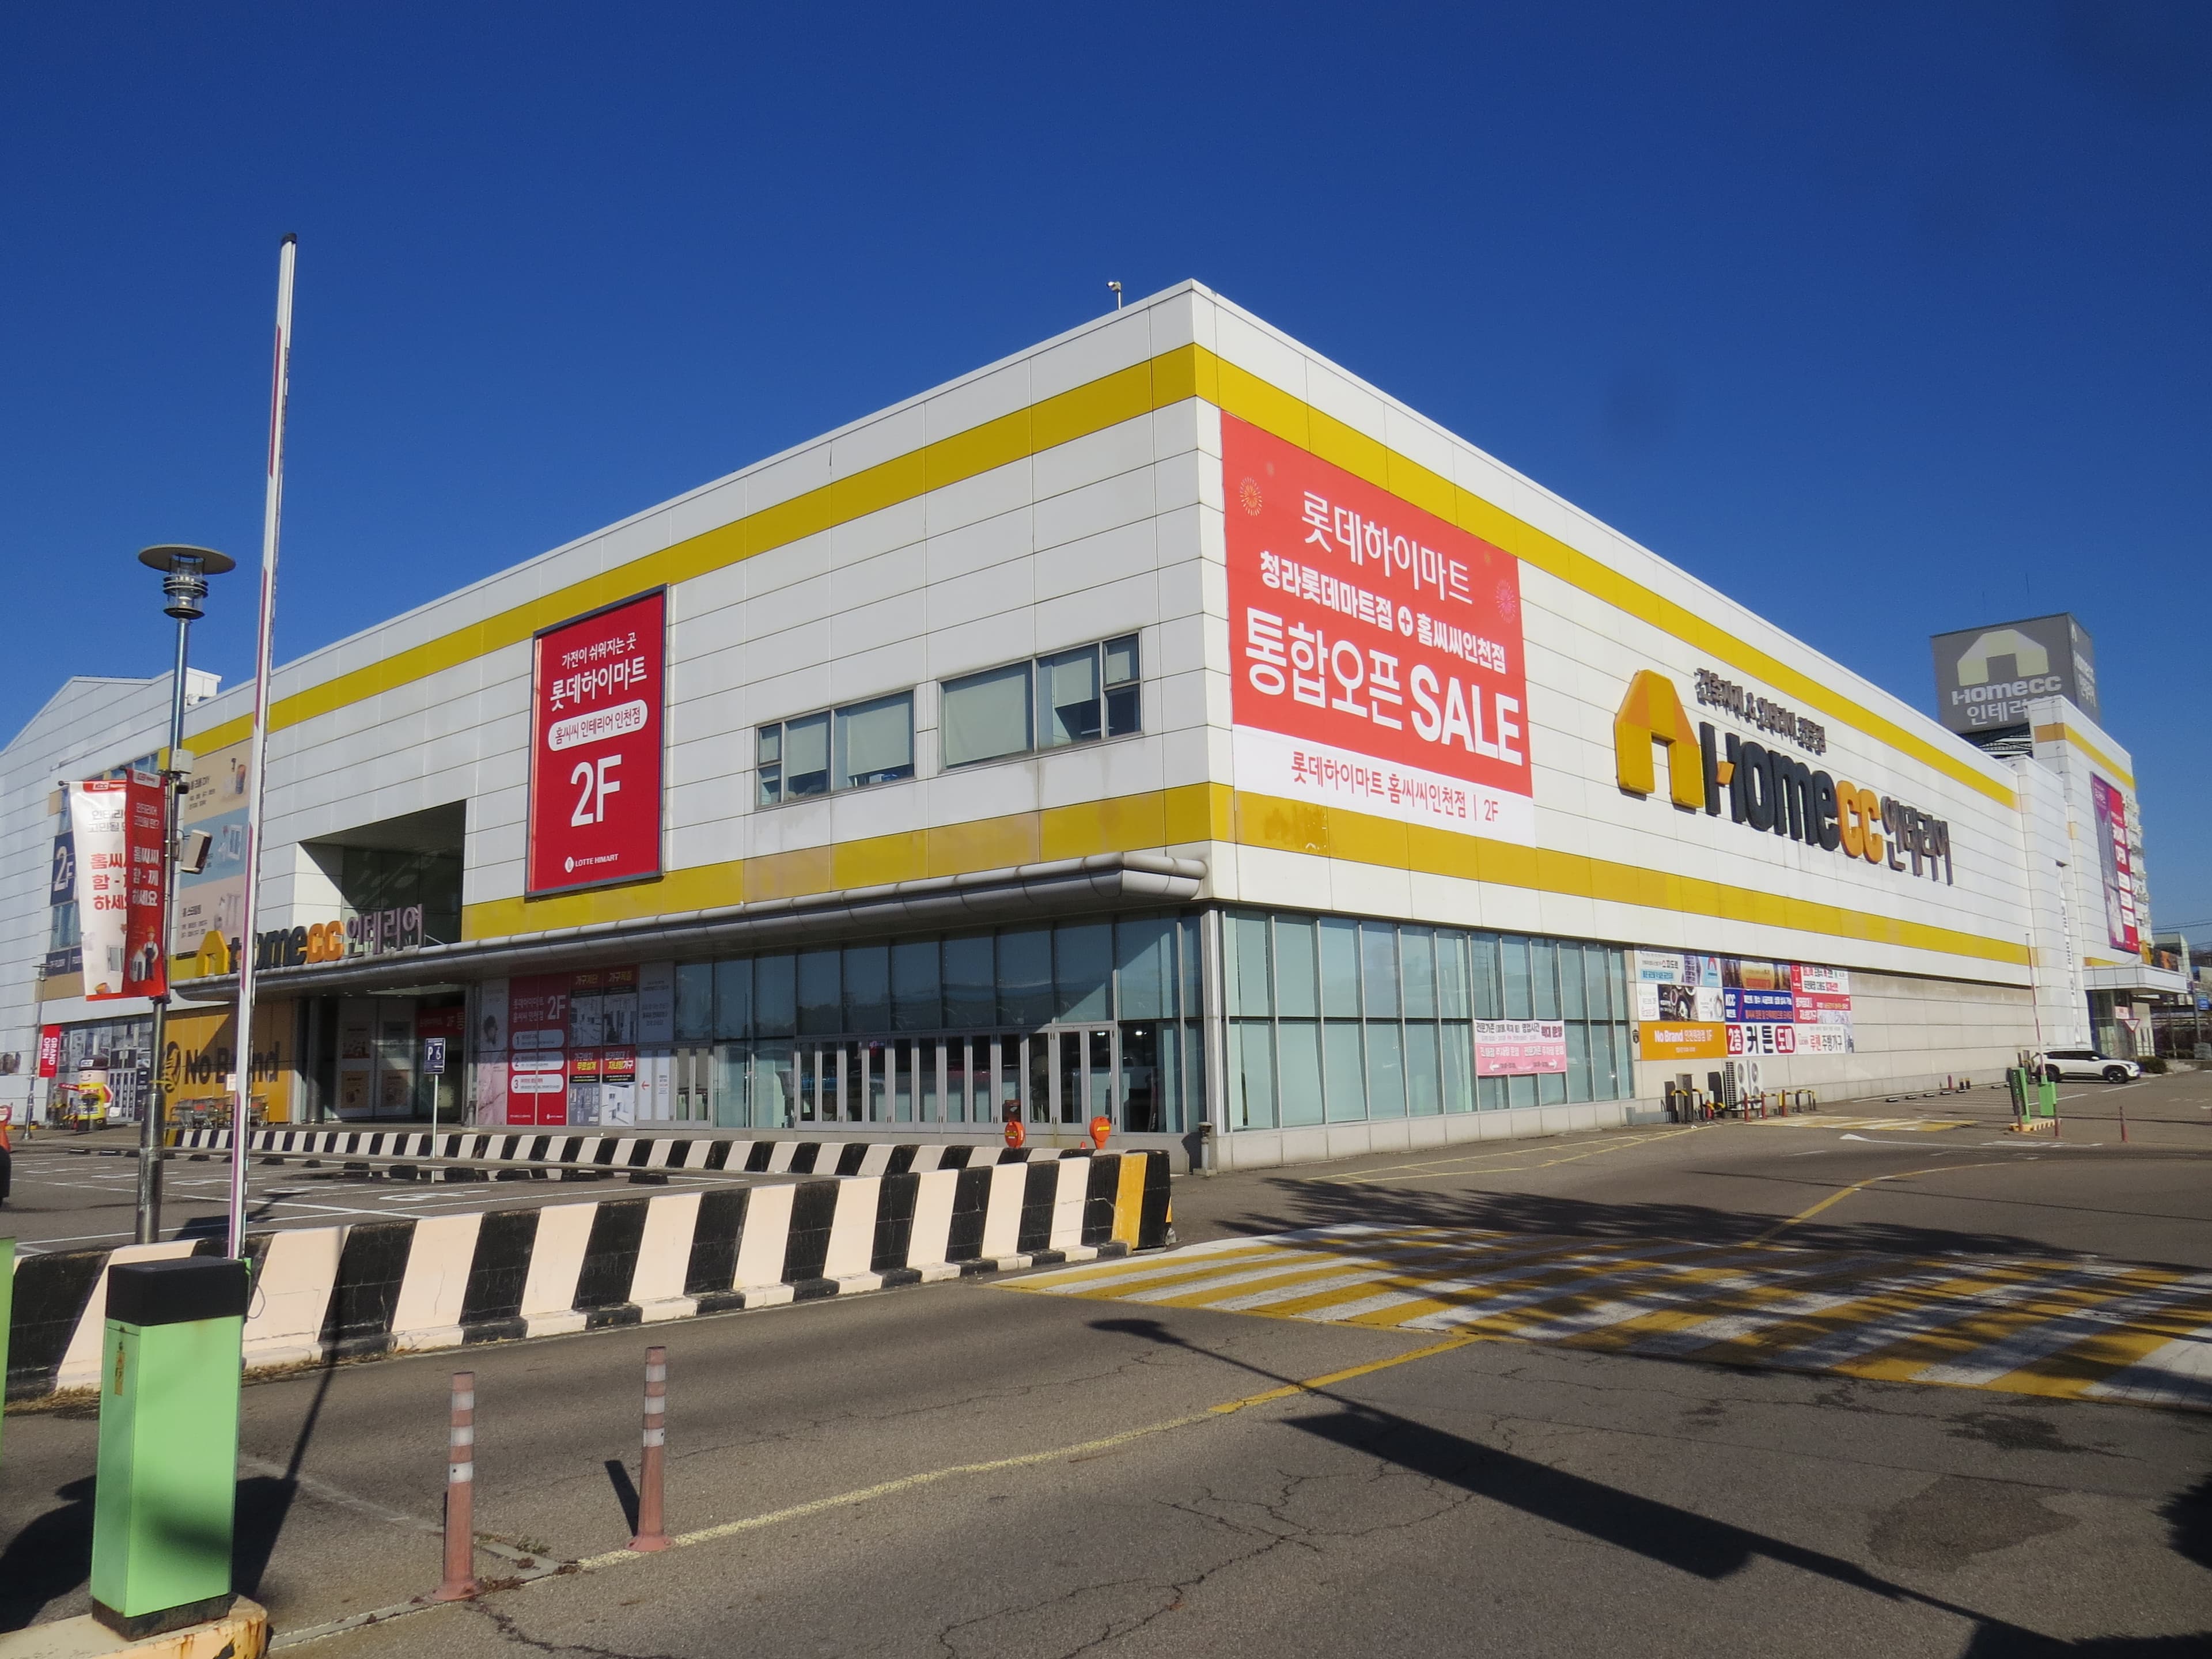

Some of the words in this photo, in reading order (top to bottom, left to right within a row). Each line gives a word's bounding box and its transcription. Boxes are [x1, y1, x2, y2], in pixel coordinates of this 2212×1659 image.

[1301, 491, 1472, 604] 롯데하이마트
[1260, 551, 1393, 632] 청라롯데마트점
[1416, 613, 1506, 675] 홈씨씨인천점
[562, 647, 587, 669] 가전이
[589, 637, 625, 661] 쉬워지는
[626, 632, 637, 651] 곳
[550, 656, 647, 712] 롯데하이마트
[1246, 607, 1402, 730] 통합오픈
[1410, 664, 1522, 766] SALE
[1952, 676, 2062, 705] Homecc
[555, 722, 579, 745] 홈씨씨
[581, 714, 613, 737] 인테리어
[615, 706, 641, 729] 인천점
[1967, 698, 2030, 726] 인테리
[570, 753, 622, 828] 2F
[1291, 751, 1384, 797] 롯데하이마트
[1388, 774, 1467, 819] 홈씨씨인천점
[1484, 799, 1499, 822] 2F
[92, 808, 125, 820] 인테리
[1699, 722, 1883, 864] Homecc
[1880, 796, 1953, 886] 인테리어
[90, 853, 127, 870] 홈씨
[575, 857, 594, 867] LOTTE
[594, 853, 619, 864] HIMART
[93, 895, 127, 911] 하세
[347, 903, 423, 959] 인테리어
[547, 994, 566, 1020] 2F
[41, 1037, 50, 1059] OPEN
[48, 1037, 58, 1066] GRAND
[1654, 1030, 1664, 1043] No
[1664, 1029, 1683, 1043] Brand
[1728, 1028, 1742, 1052] 2층
[1777, 1028, 1793, 1051] 도매
[184, 1048, 211, 1085] No
